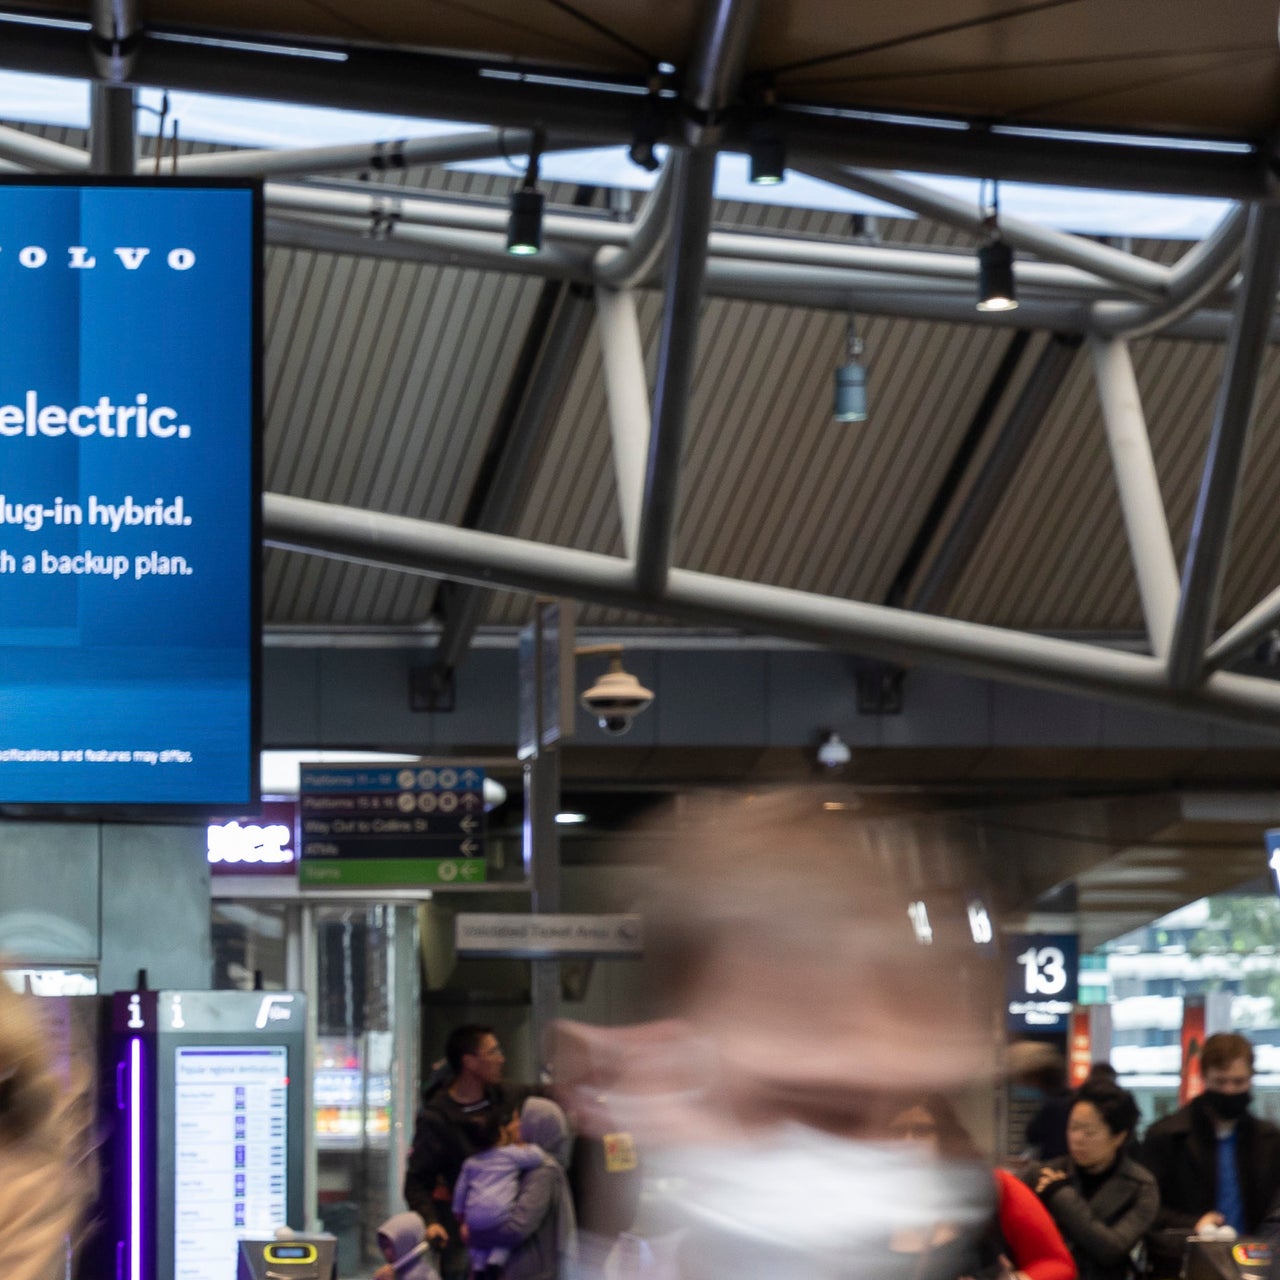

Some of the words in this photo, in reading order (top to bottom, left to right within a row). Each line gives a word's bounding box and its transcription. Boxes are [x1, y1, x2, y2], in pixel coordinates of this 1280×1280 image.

[88, 496, 192, 533] hybrid.
[22, 556, 36, 574] a
[41, 551, 129, 580] backup
[135, 551, 193, 580] plan.
[61, 750, 83, 763] and
[132, 751, 158, 765] may
[1016, 946, 1068, 995] 13
